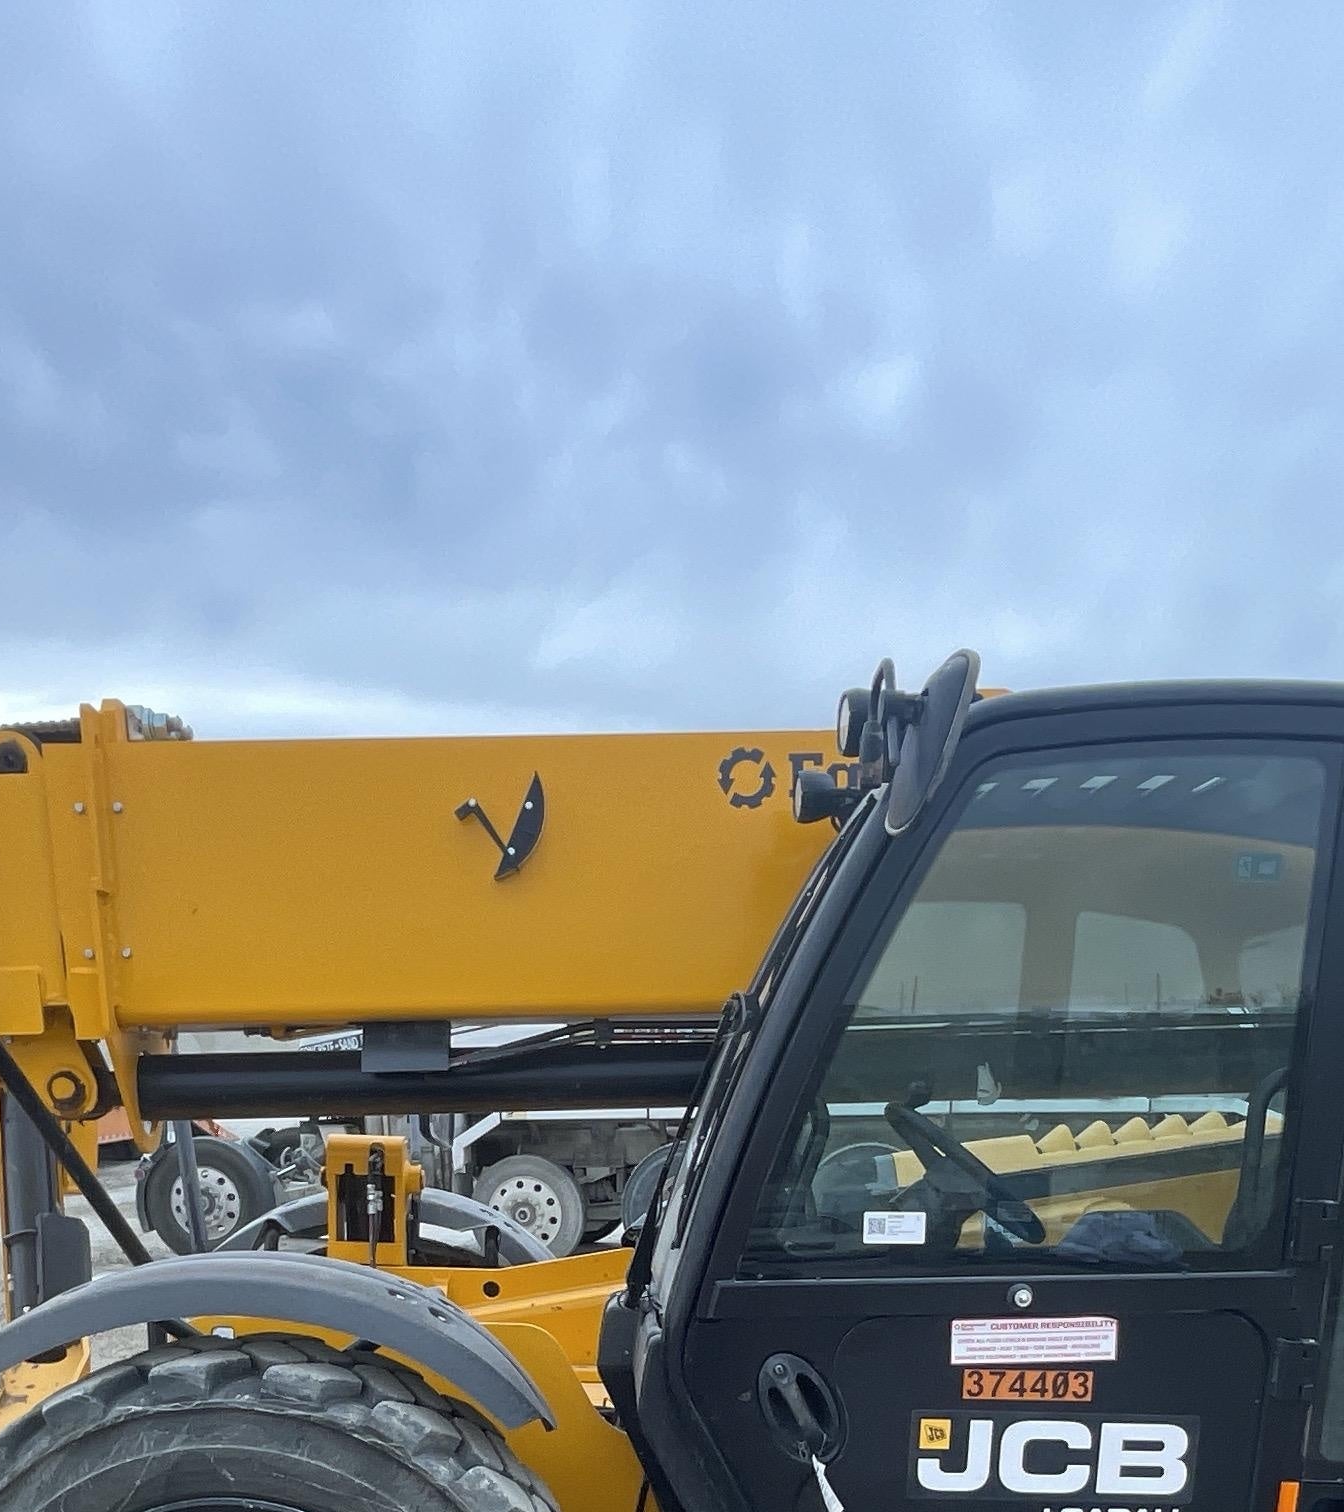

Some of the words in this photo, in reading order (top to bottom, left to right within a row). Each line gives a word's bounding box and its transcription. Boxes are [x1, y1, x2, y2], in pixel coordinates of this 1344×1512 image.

[990, 1321, 1039, 1331] CUSTOMER
[1040, 1320, 1115, 1330] RESPONSIBILITY
[966, 1370, 1090, 1399] 374403
[917, 1419, 1189, 1495] JCB
